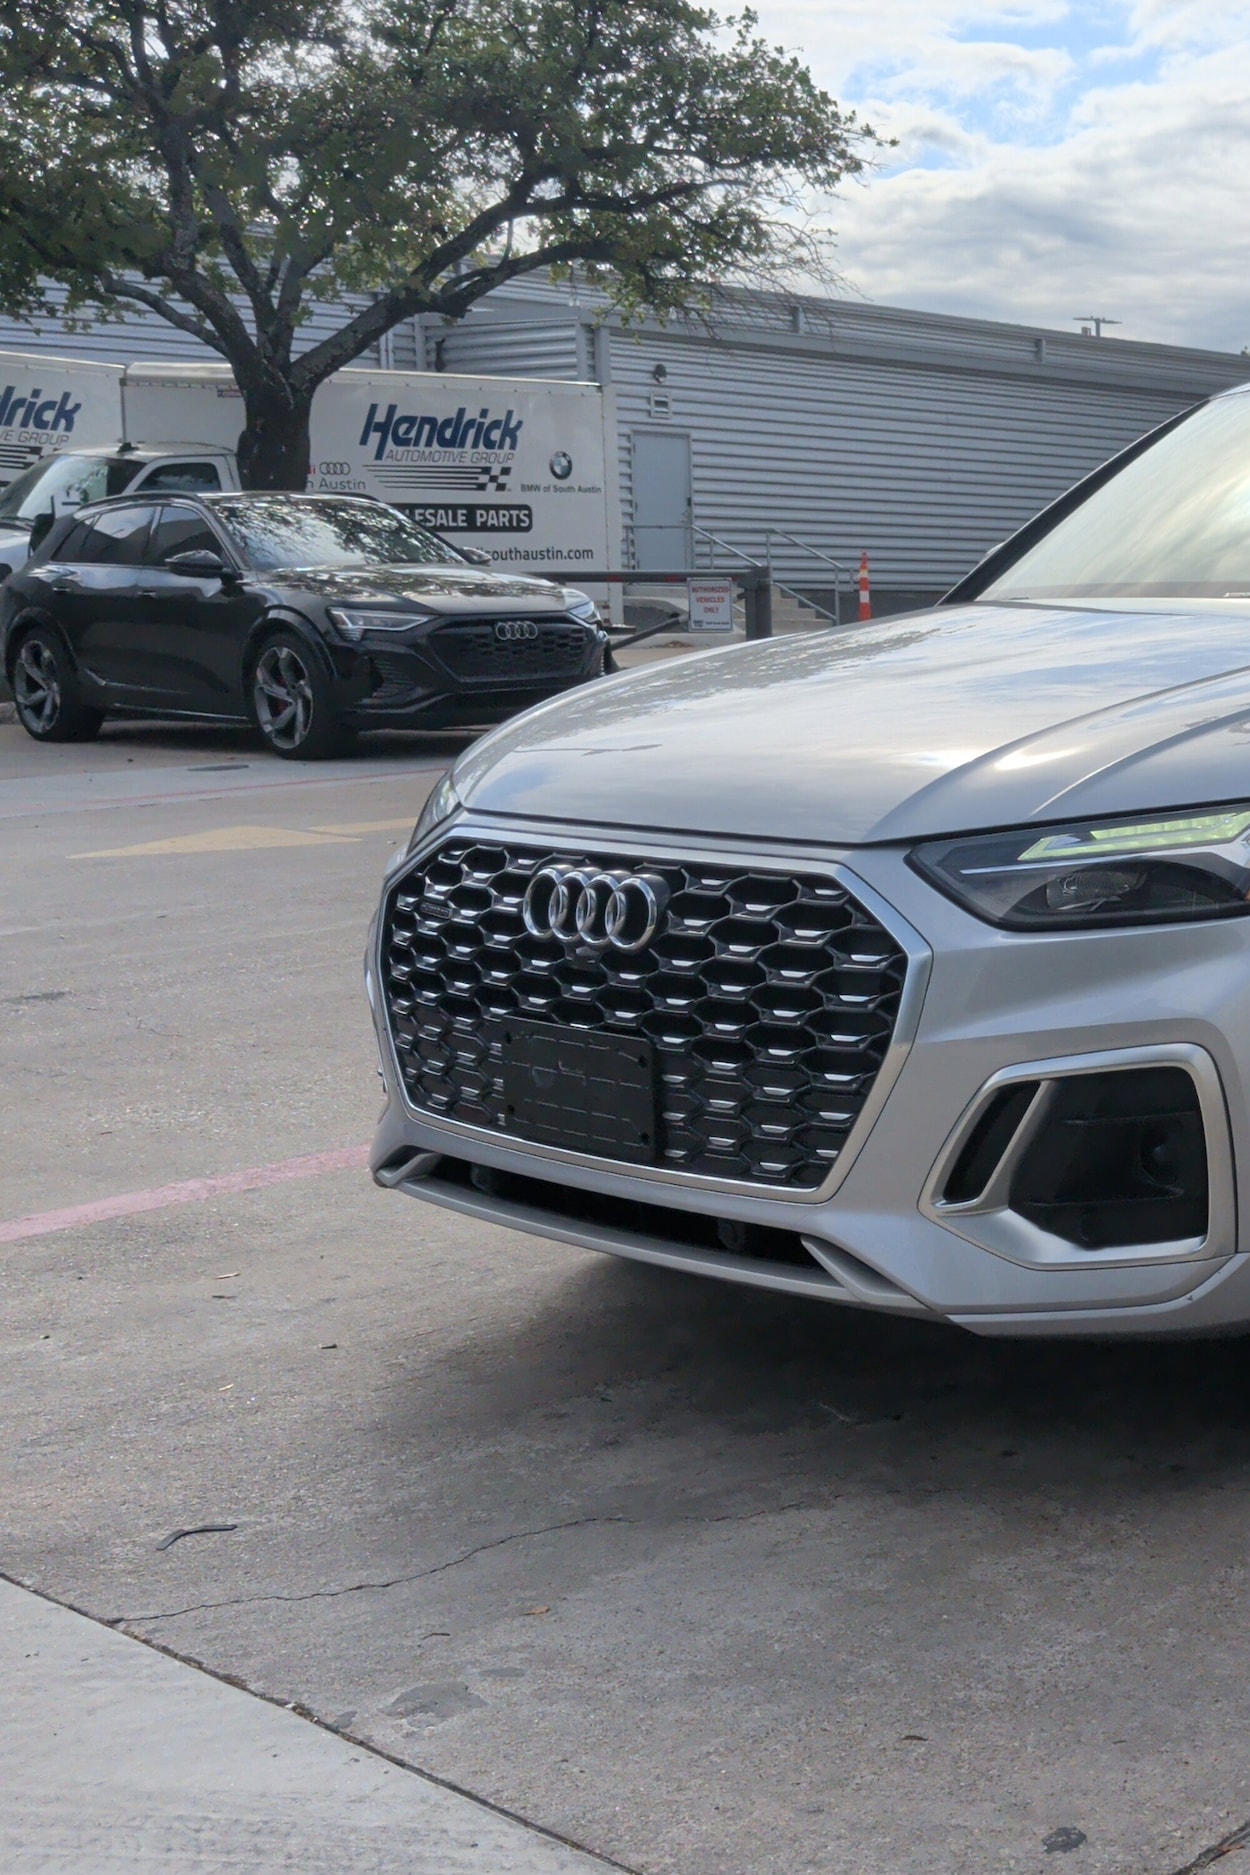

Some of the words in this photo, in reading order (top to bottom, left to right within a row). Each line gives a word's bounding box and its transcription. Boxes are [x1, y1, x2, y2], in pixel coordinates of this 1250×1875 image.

[18, 430, 70, 446] GROUP
[359, 403, 523, 461] Hendrick
[385, 449, 468, 464] AUTOMOTIVE
[470, 451, 515, 465] GROUP
[319, 478, 366, 490] Austin
[520, 484, 541, 493] BMW
[543, 485, 551, 493] of
[552, 485, 576, 493] South
[577, 485, 602, 494] Austin
[405, 509, 467, 527] ESALE
[476, 510, 530, 527] PARTS
